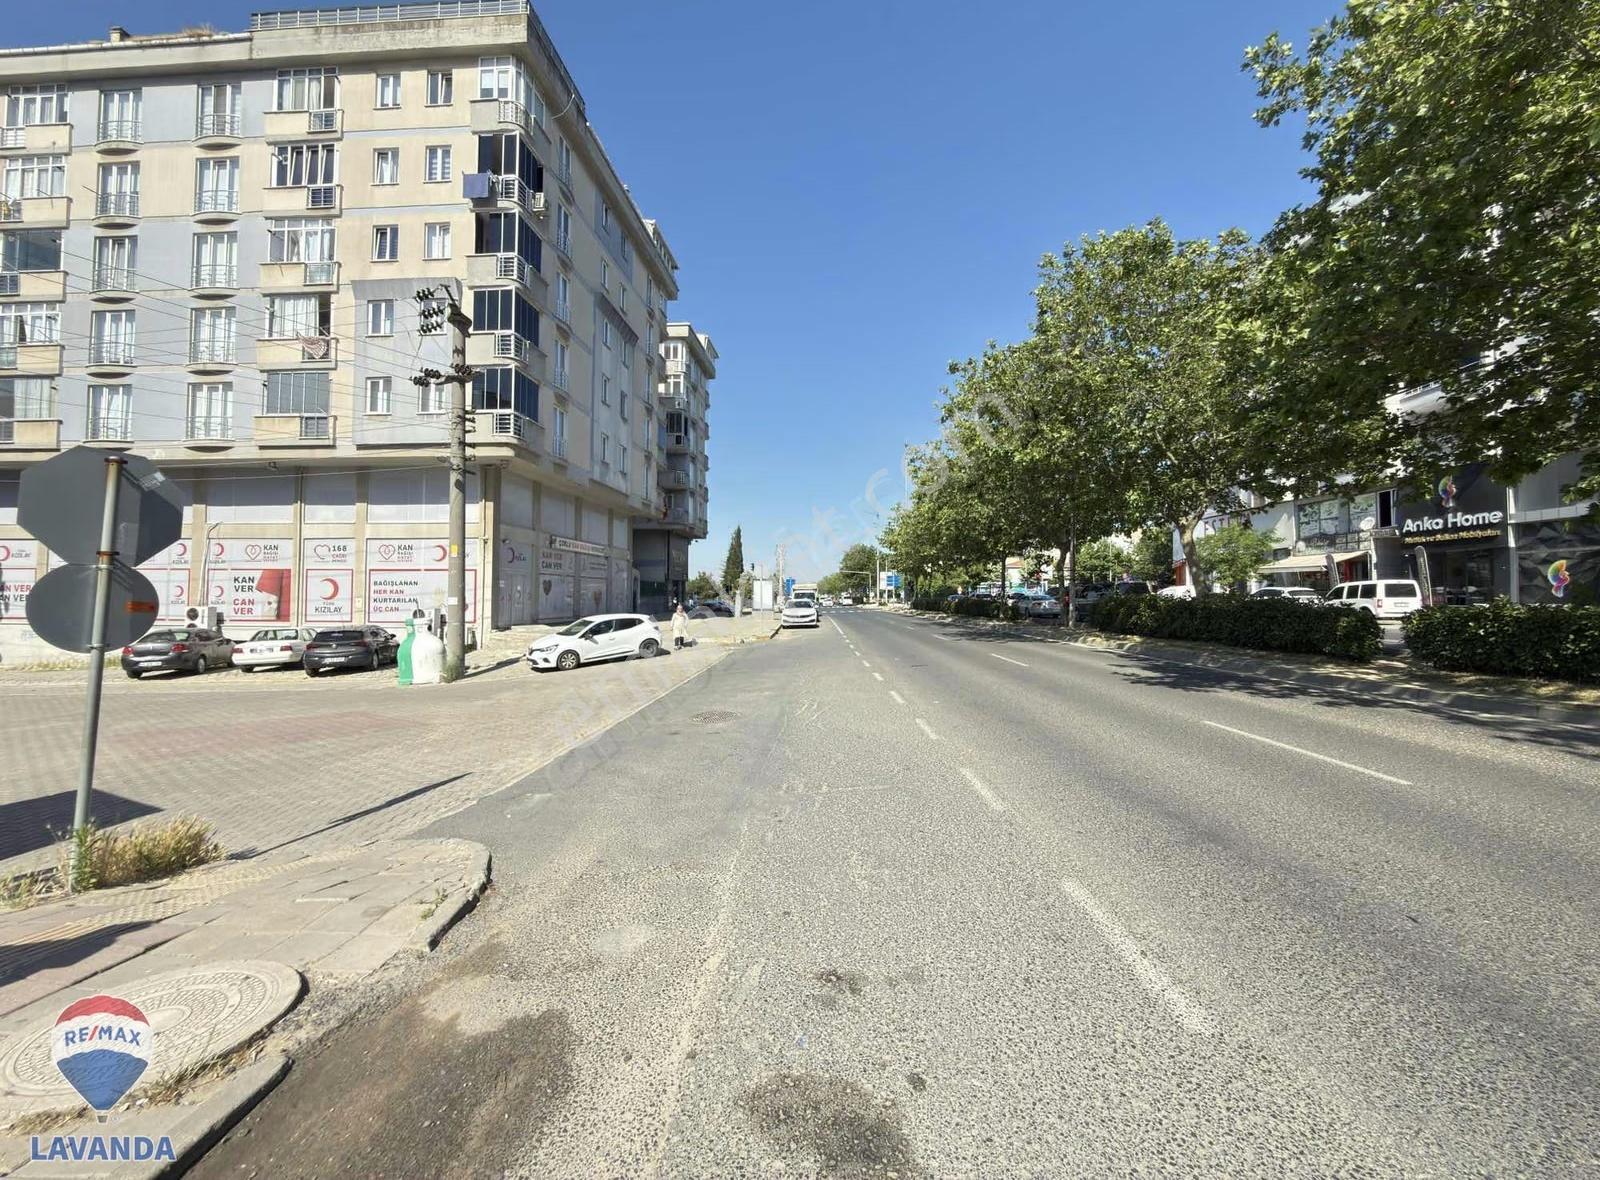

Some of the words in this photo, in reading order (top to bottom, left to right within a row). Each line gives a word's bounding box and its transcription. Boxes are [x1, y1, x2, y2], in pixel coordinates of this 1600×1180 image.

[1402, 516, 1444, 533] Anka
[1447, 510, 1504, 528] Home
[233, 576, 255, 584] KAN
[373, 579, 418, 587] BAĞIŞLANAN
[14, 584, 32, 592] VER
[233, 598, 255, 606] CAN
[233, 607, 254, 615] VER
